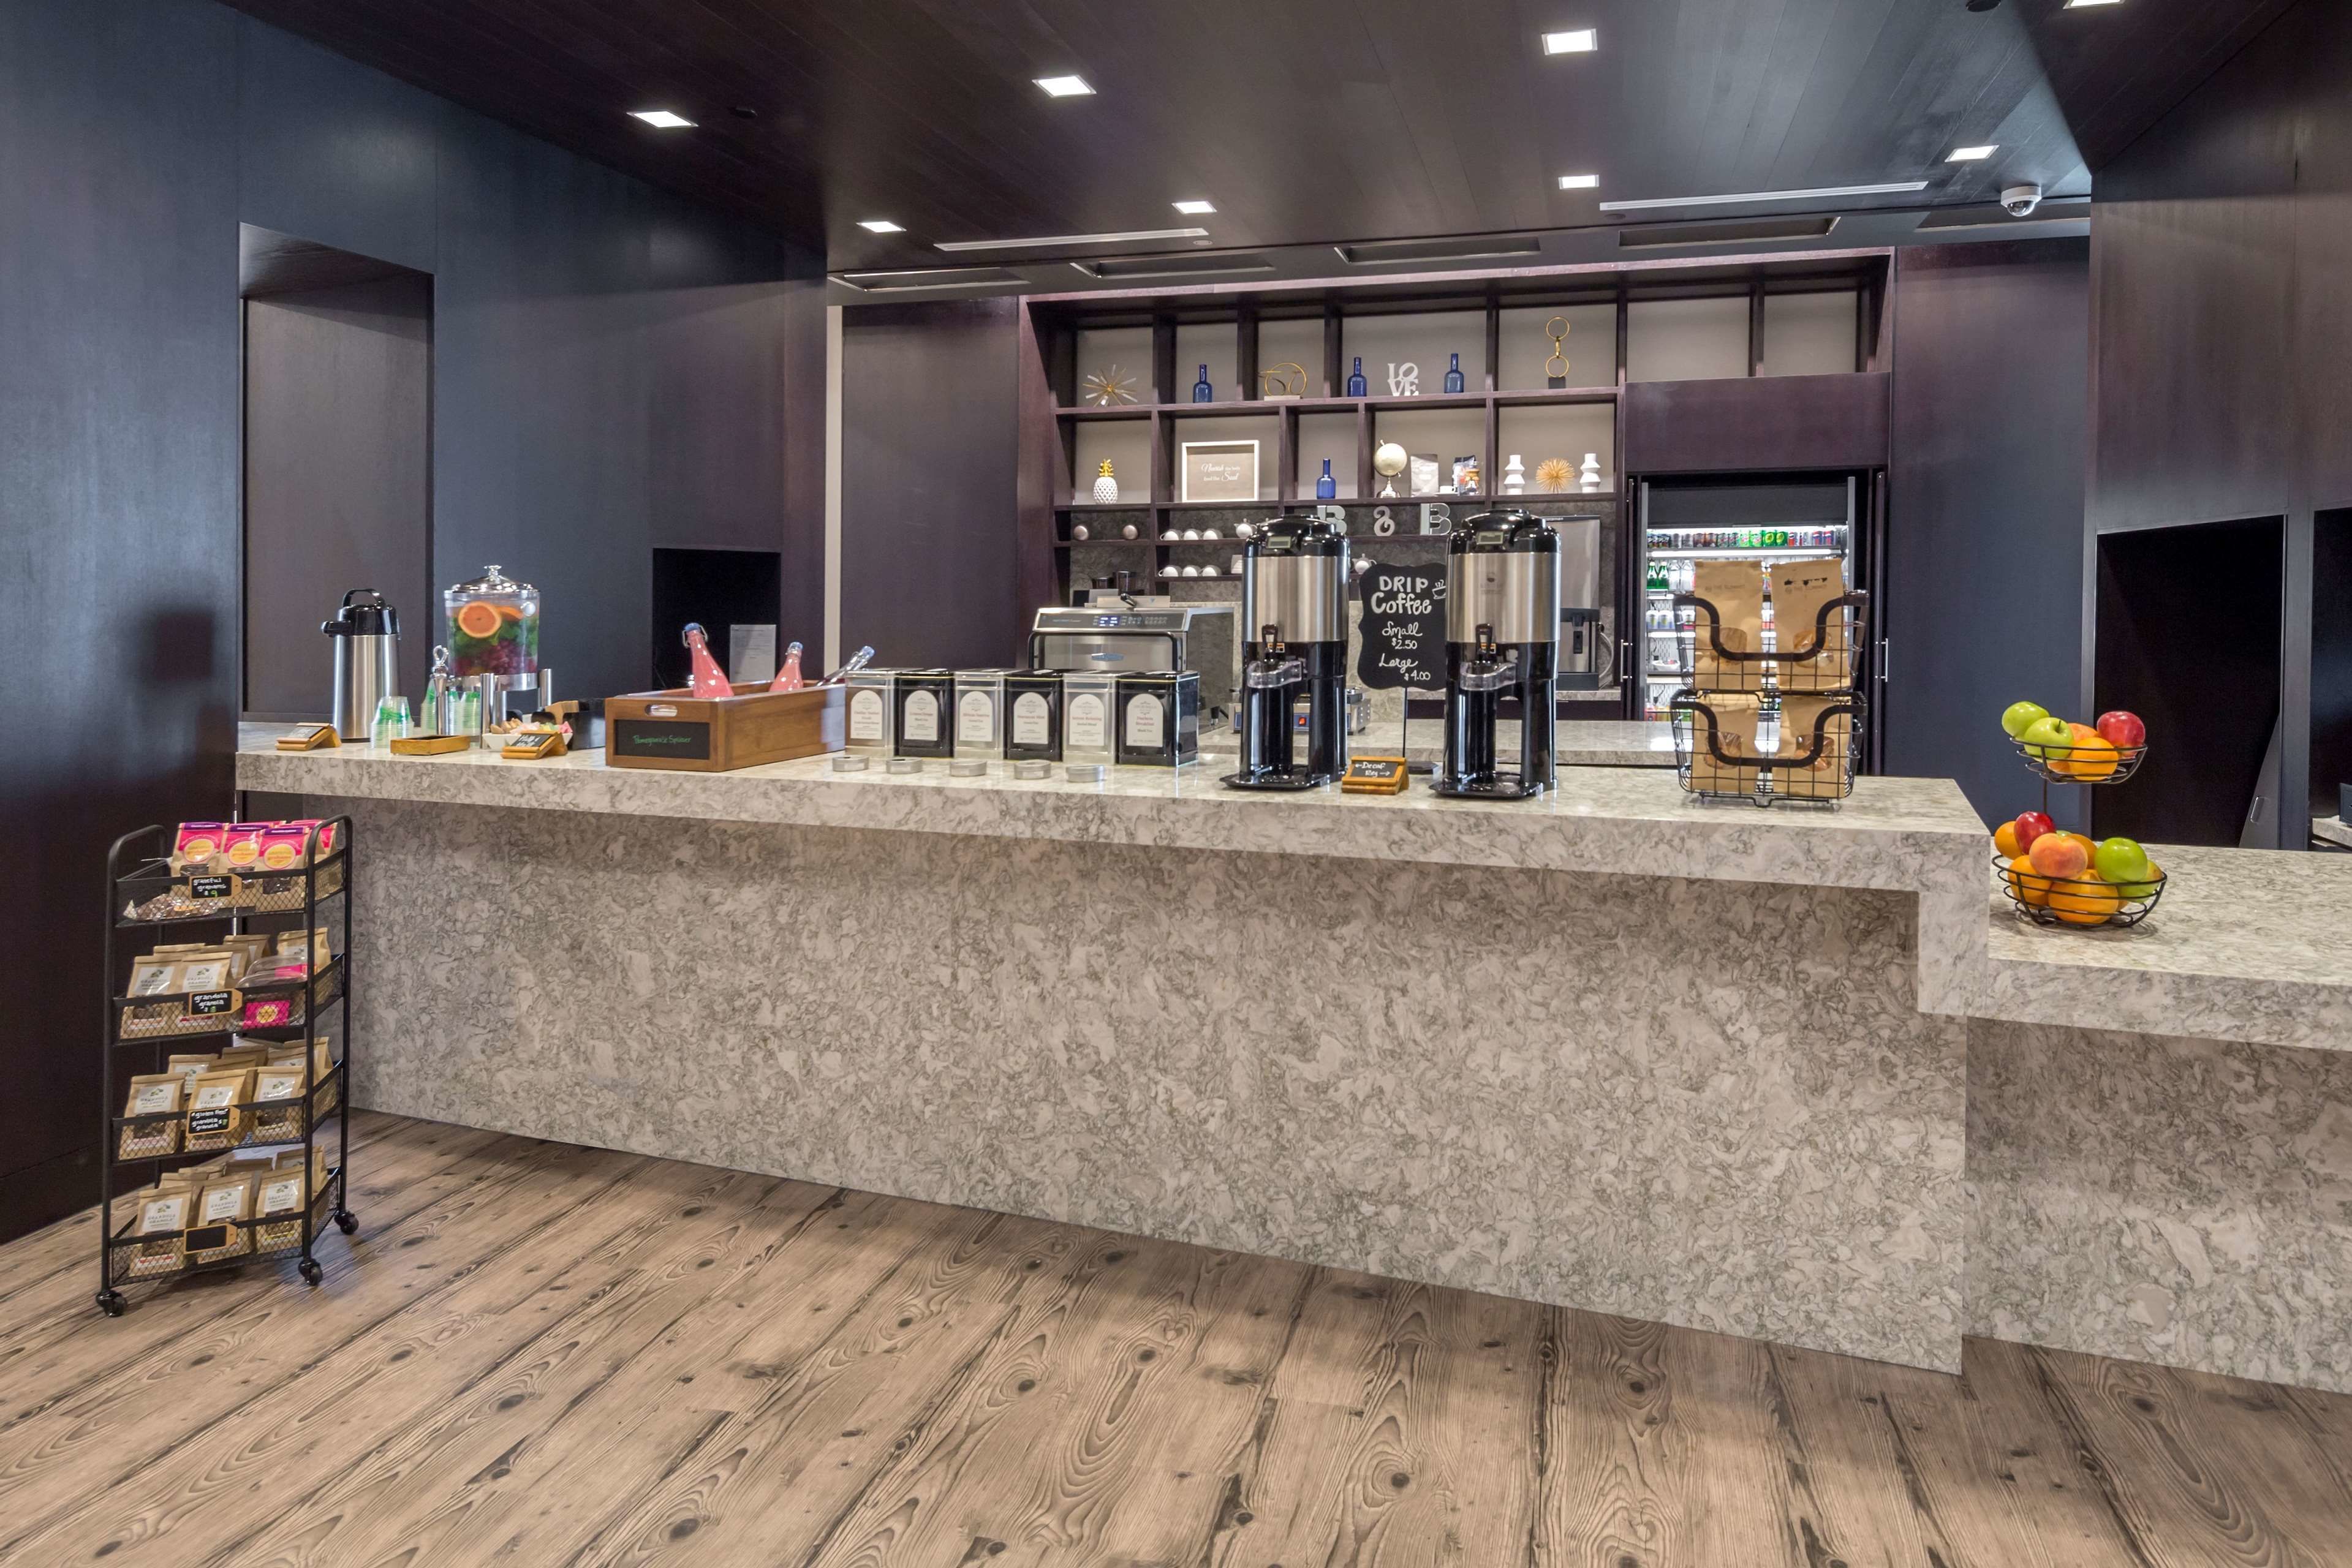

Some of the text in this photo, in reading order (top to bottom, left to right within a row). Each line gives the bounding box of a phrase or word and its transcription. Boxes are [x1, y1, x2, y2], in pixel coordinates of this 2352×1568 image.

[1420, 503, 1452, 535] B
[1378, 576, 1428, 593] DRIP
[1371, 592, 1432, 615] Coffee
[1382, 621, 1423, 638] Small
[1391, 638, 1418, 650] $2.50
[1378, 653, 1418, 673] Large
[1404, 670, 1431, 681] $4.00
[194, 993, 228, 1003] grandola
